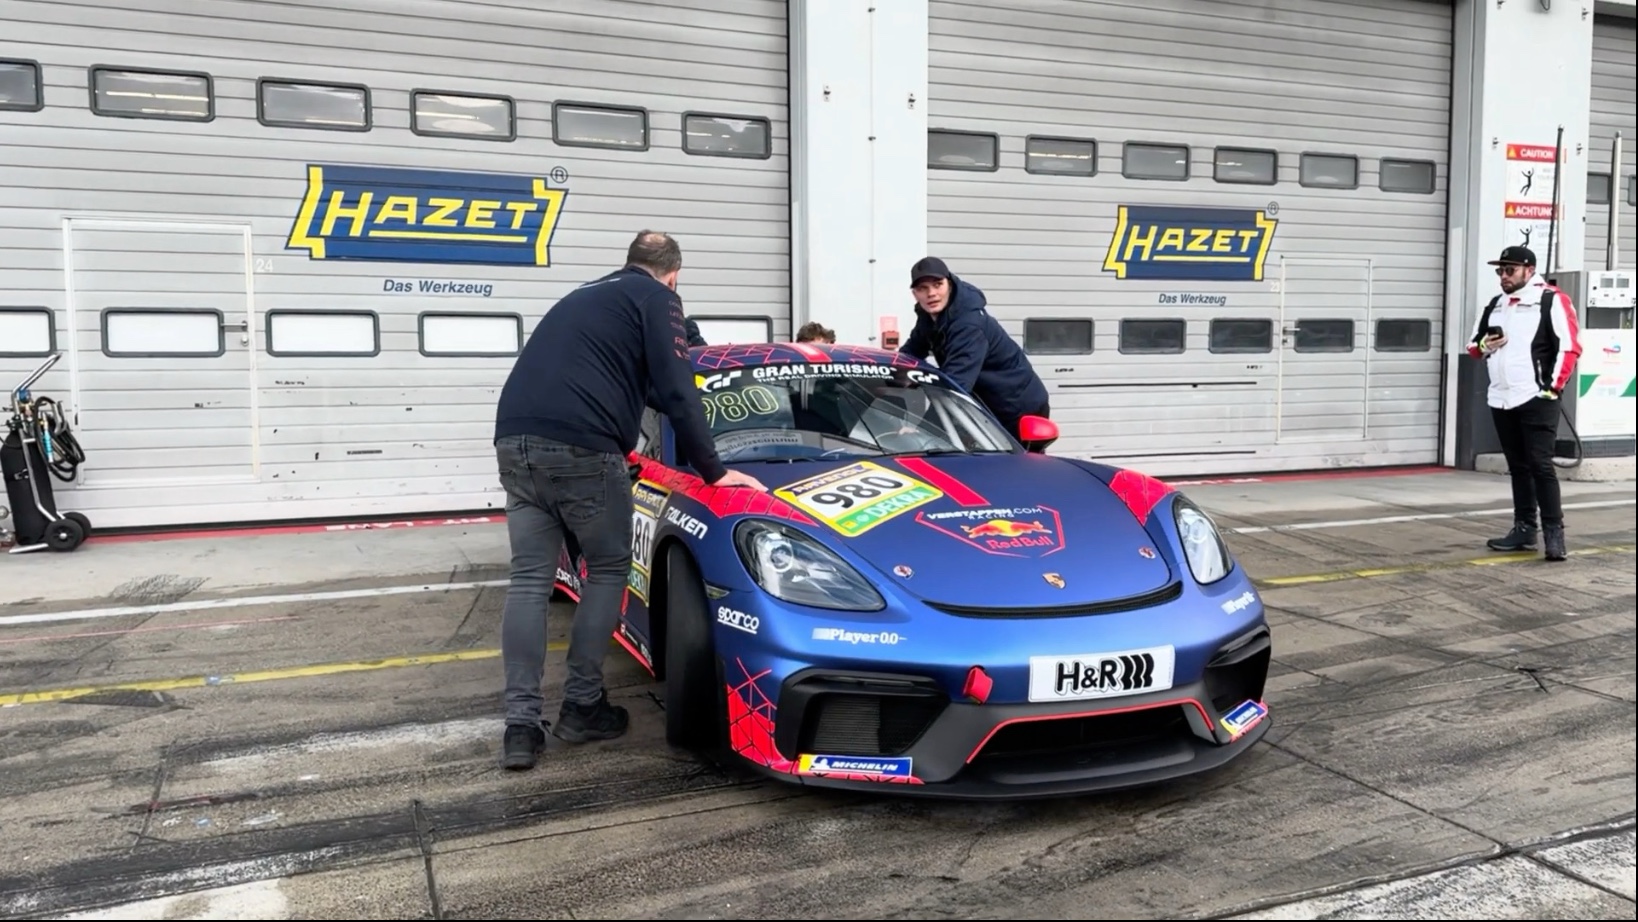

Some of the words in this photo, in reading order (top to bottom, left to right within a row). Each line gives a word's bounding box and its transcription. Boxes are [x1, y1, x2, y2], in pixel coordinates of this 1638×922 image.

[1520, 148, 1554, 159] CAUTION
[319, 190, 538, 237] HAZET
[1122, 225, 1260, 261] HAZET
[256, 258, 274, 273] 24
[383, 279, 413, 292] Das
[418, 280, 493, 297] Werkzeug
[1158, 293, 1178, 304] Das
[1180, 294, 1227, 307] Werkzeug
[752, 364, 806, 379] GRAN
[811, 476, 904, 509] 980
[864, 489, 933, 518] DEKRA
[664, 505, 709, 540] FALKEN
[634, 516, 650, 566] 80
[717, 606, 760, 632] sparco
[829, 628, 879, 645] Player
[831, 760, 899, 772] MICHELIN
